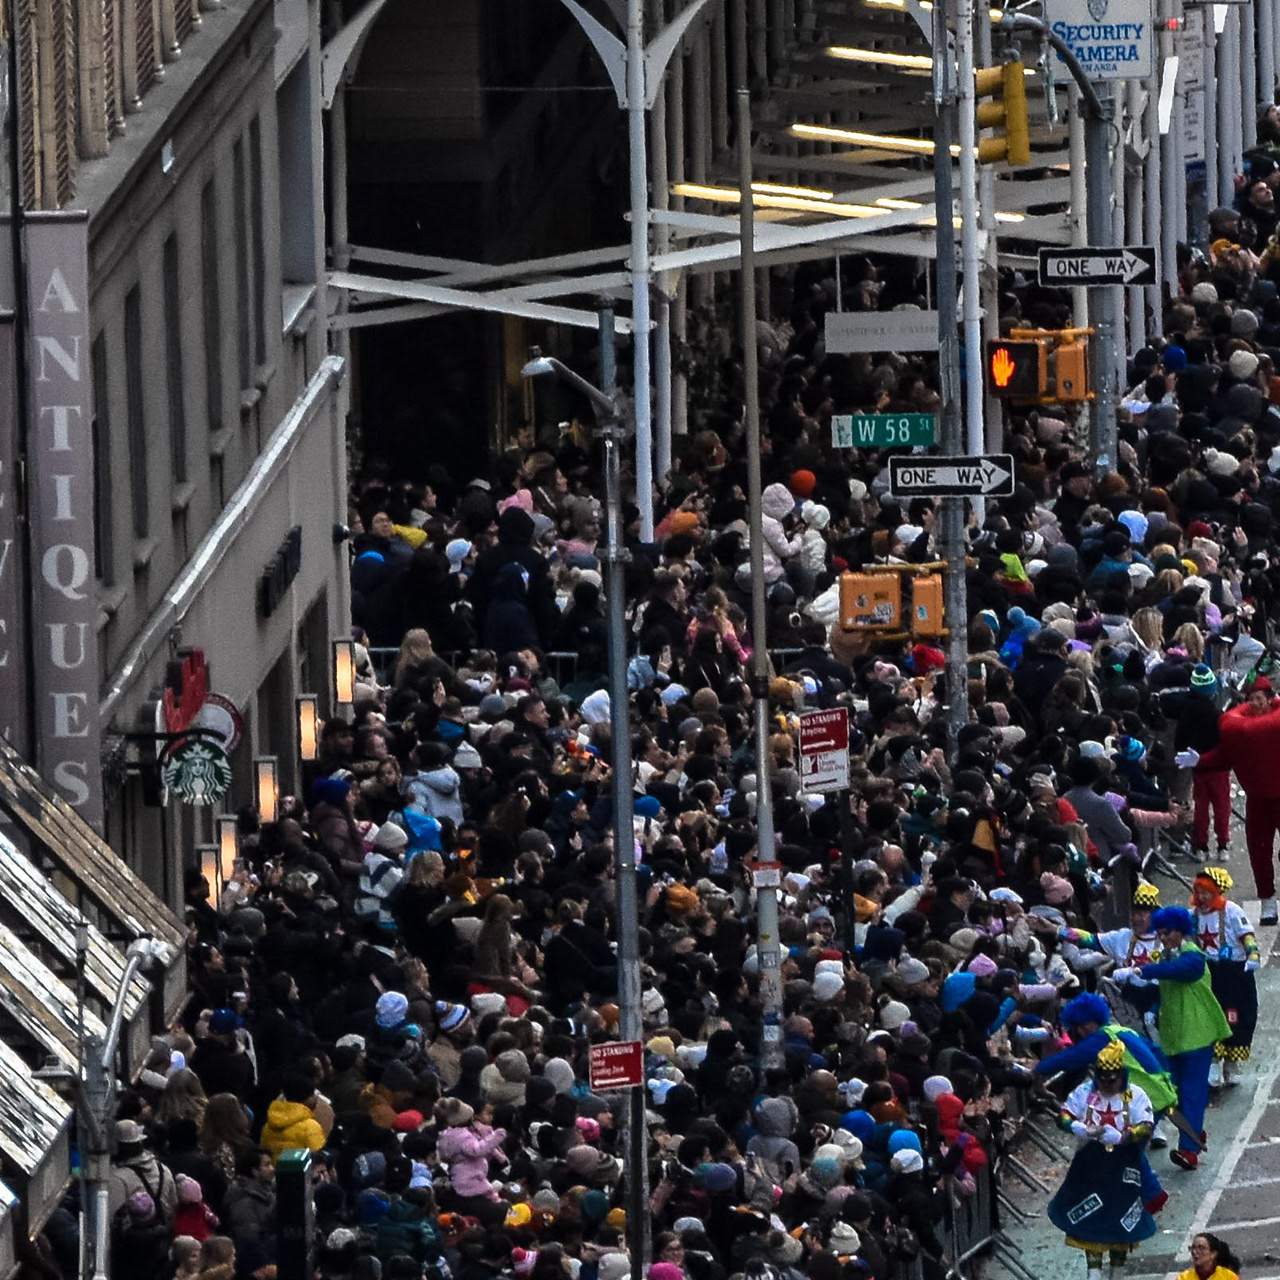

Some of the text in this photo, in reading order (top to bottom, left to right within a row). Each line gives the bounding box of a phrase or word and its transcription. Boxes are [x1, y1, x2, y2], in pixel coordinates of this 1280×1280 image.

[1052, 21, 1144, 42] SECURITY
[1056, 258, 1137, 275] ONE WAY
[858, 417, 931, 442] W 58 St
[901, 468, 996, 484] ONE WAY
[36, 267, 91, 808] ANTIQUES
